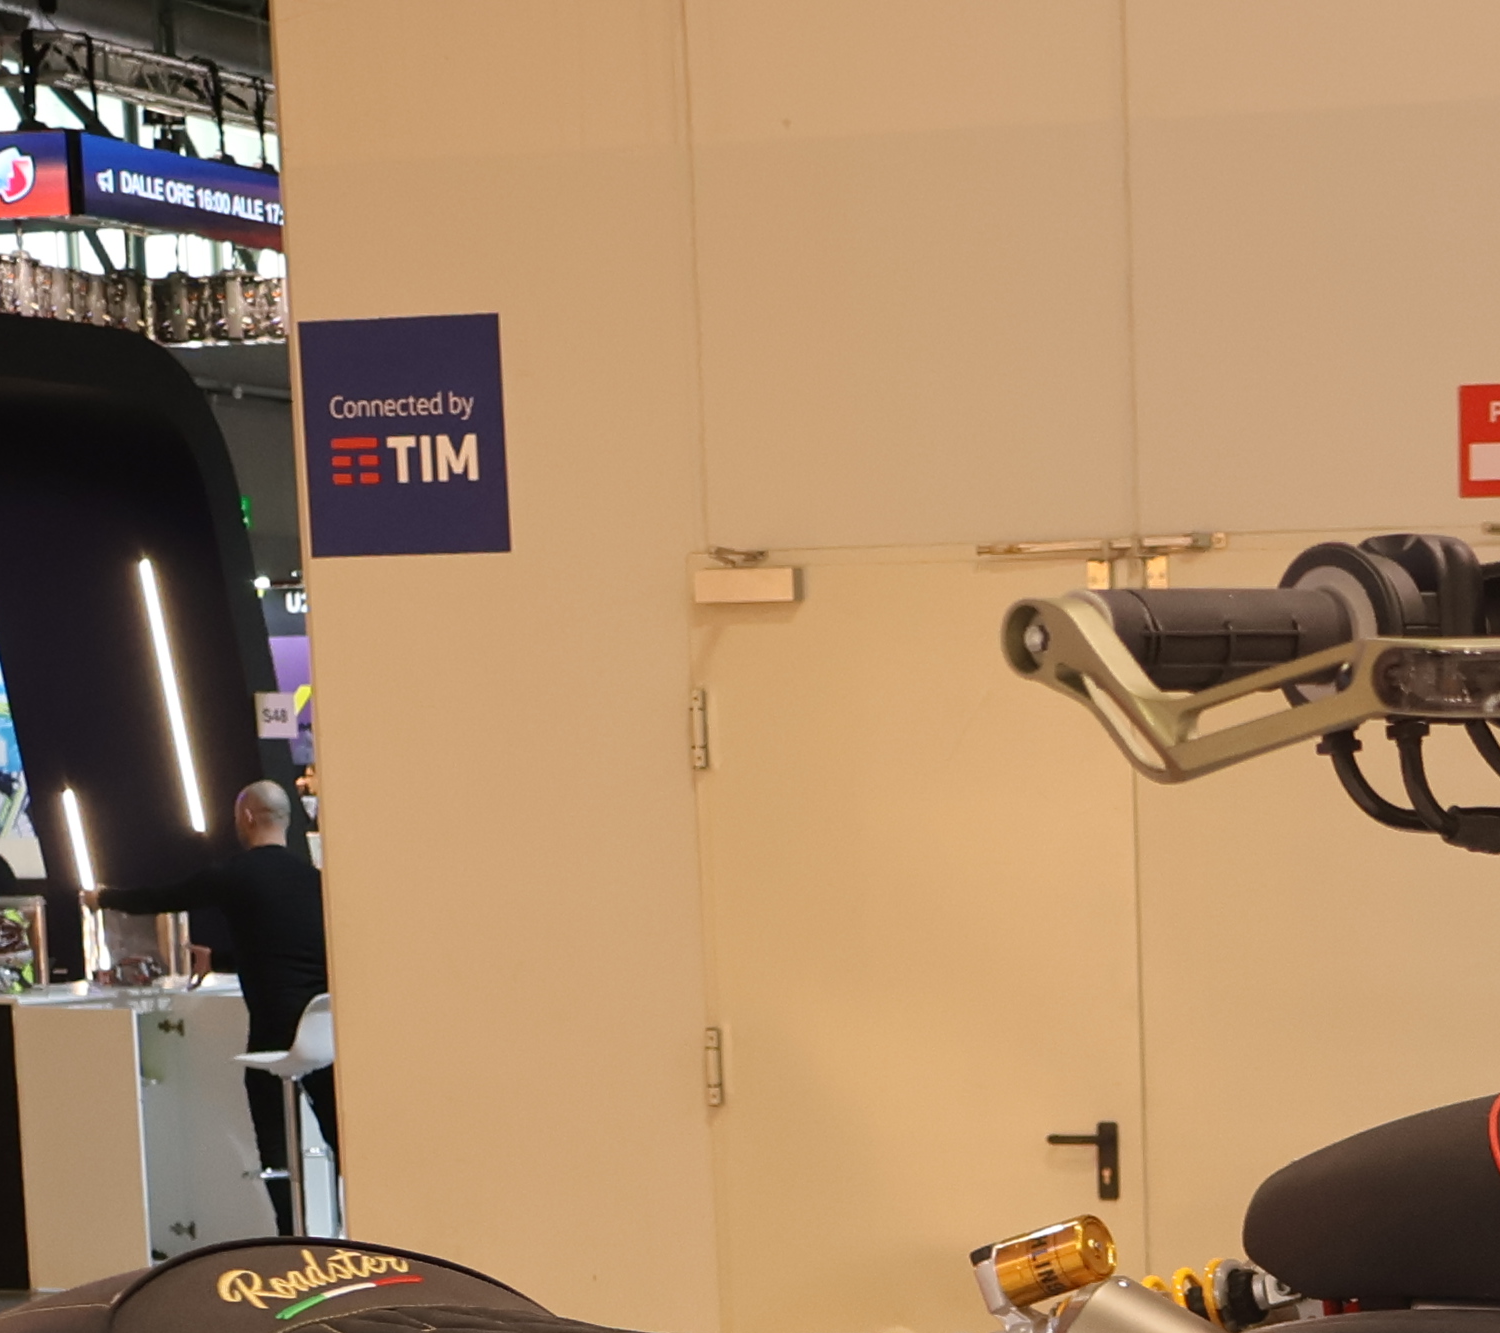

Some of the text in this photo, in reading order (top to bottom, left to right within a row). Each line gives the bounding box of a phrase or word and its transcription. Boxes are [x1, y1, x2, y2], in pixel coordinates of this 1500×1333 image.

[119, 171, 285, 226] DALLE ORE 16:00 ALLE 17:
[328, 390, 474, 420] Connected by
[386, 433, 479, 483] TIM
[216, 1249, 409, 1310] Roadster
